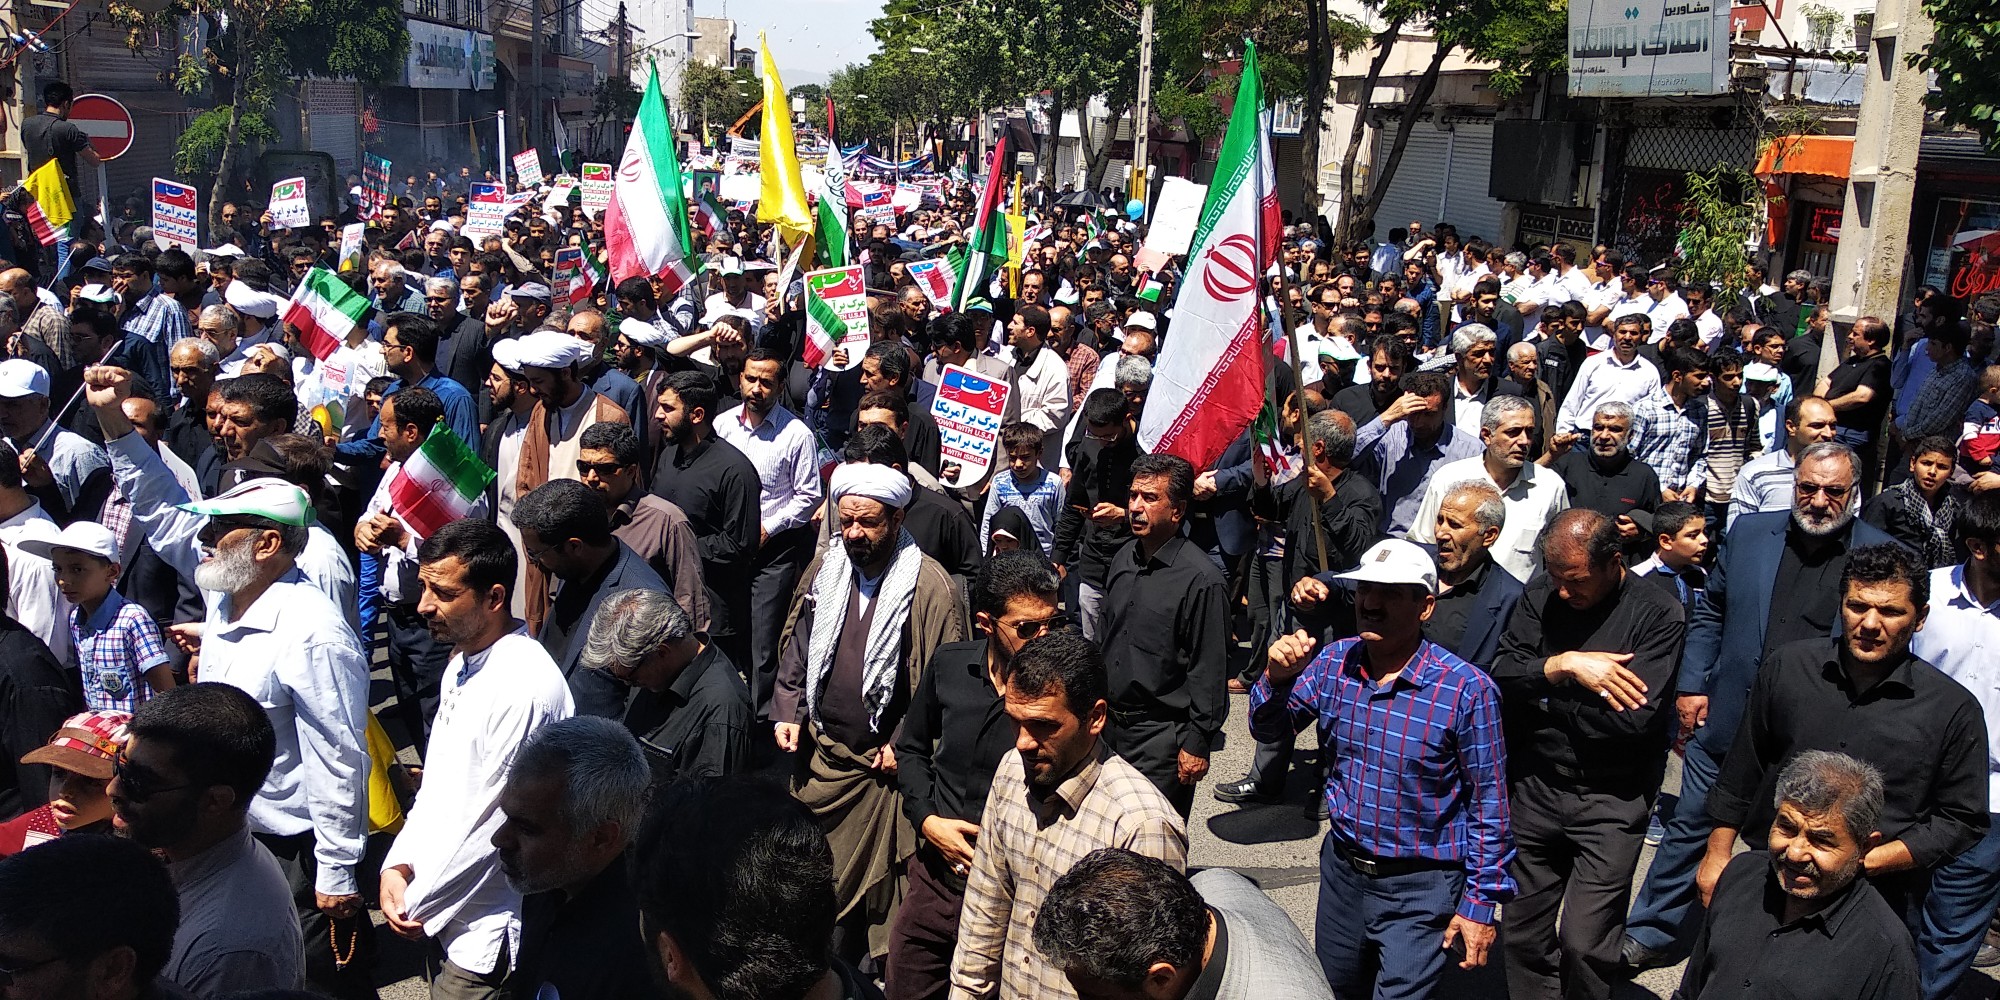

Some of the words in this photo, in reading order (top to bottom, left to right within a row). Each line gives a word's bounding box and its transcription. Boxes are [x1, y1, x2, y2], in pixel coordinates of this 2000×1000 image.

[1665, 3, 1709, 17] مشاورین
[847, 298, 866, 311] مرگ
[935, 400, 969, 419] آمریکا
[965, 415, 977, 425] بر
[978, 416, 998, 431] مرگ
[956, 423, 973, 434] WITH
[974, 430, 993, 441] U.S.A
[972, 441, 991, 454] مرگ
[946, 447, 963, 458] WITH
[963, 453, 985, 465] ISRAEL
